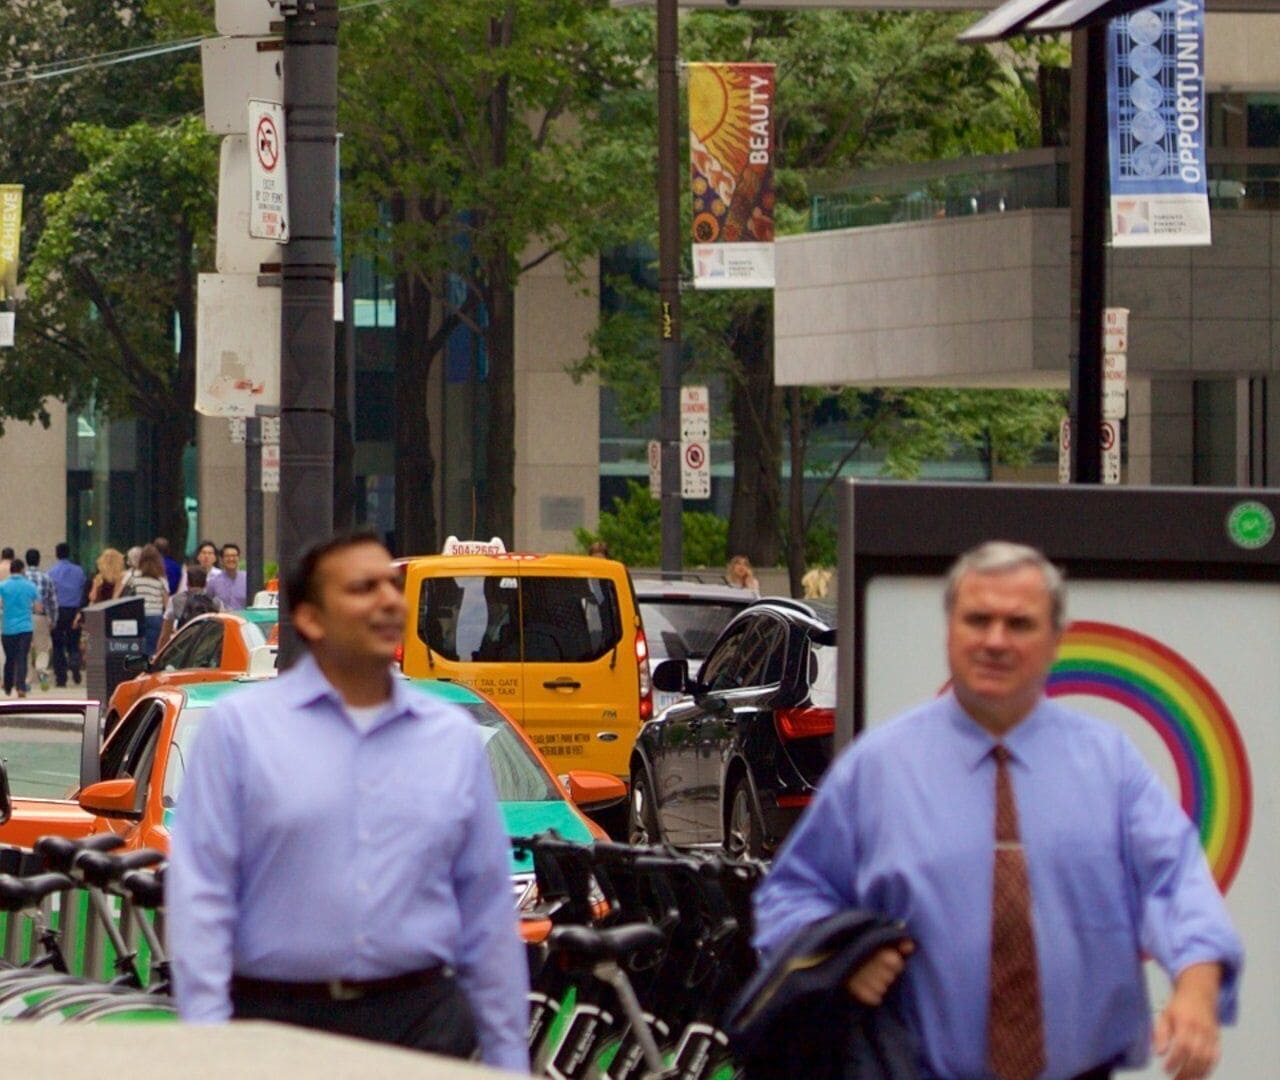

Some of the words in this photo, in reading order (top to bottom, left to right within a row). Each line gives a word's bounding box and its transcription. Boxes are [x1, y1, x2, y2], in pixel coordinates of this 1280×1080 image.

[749, 75, 770, 164] BEAUTY
[1176, 0, 1200, 184] OPPORTUNITY
[1, 192, 18, 262] ACHIEVE
[109, 642, 129, 651] Litter
[498, 679, 519, 687] GATE
